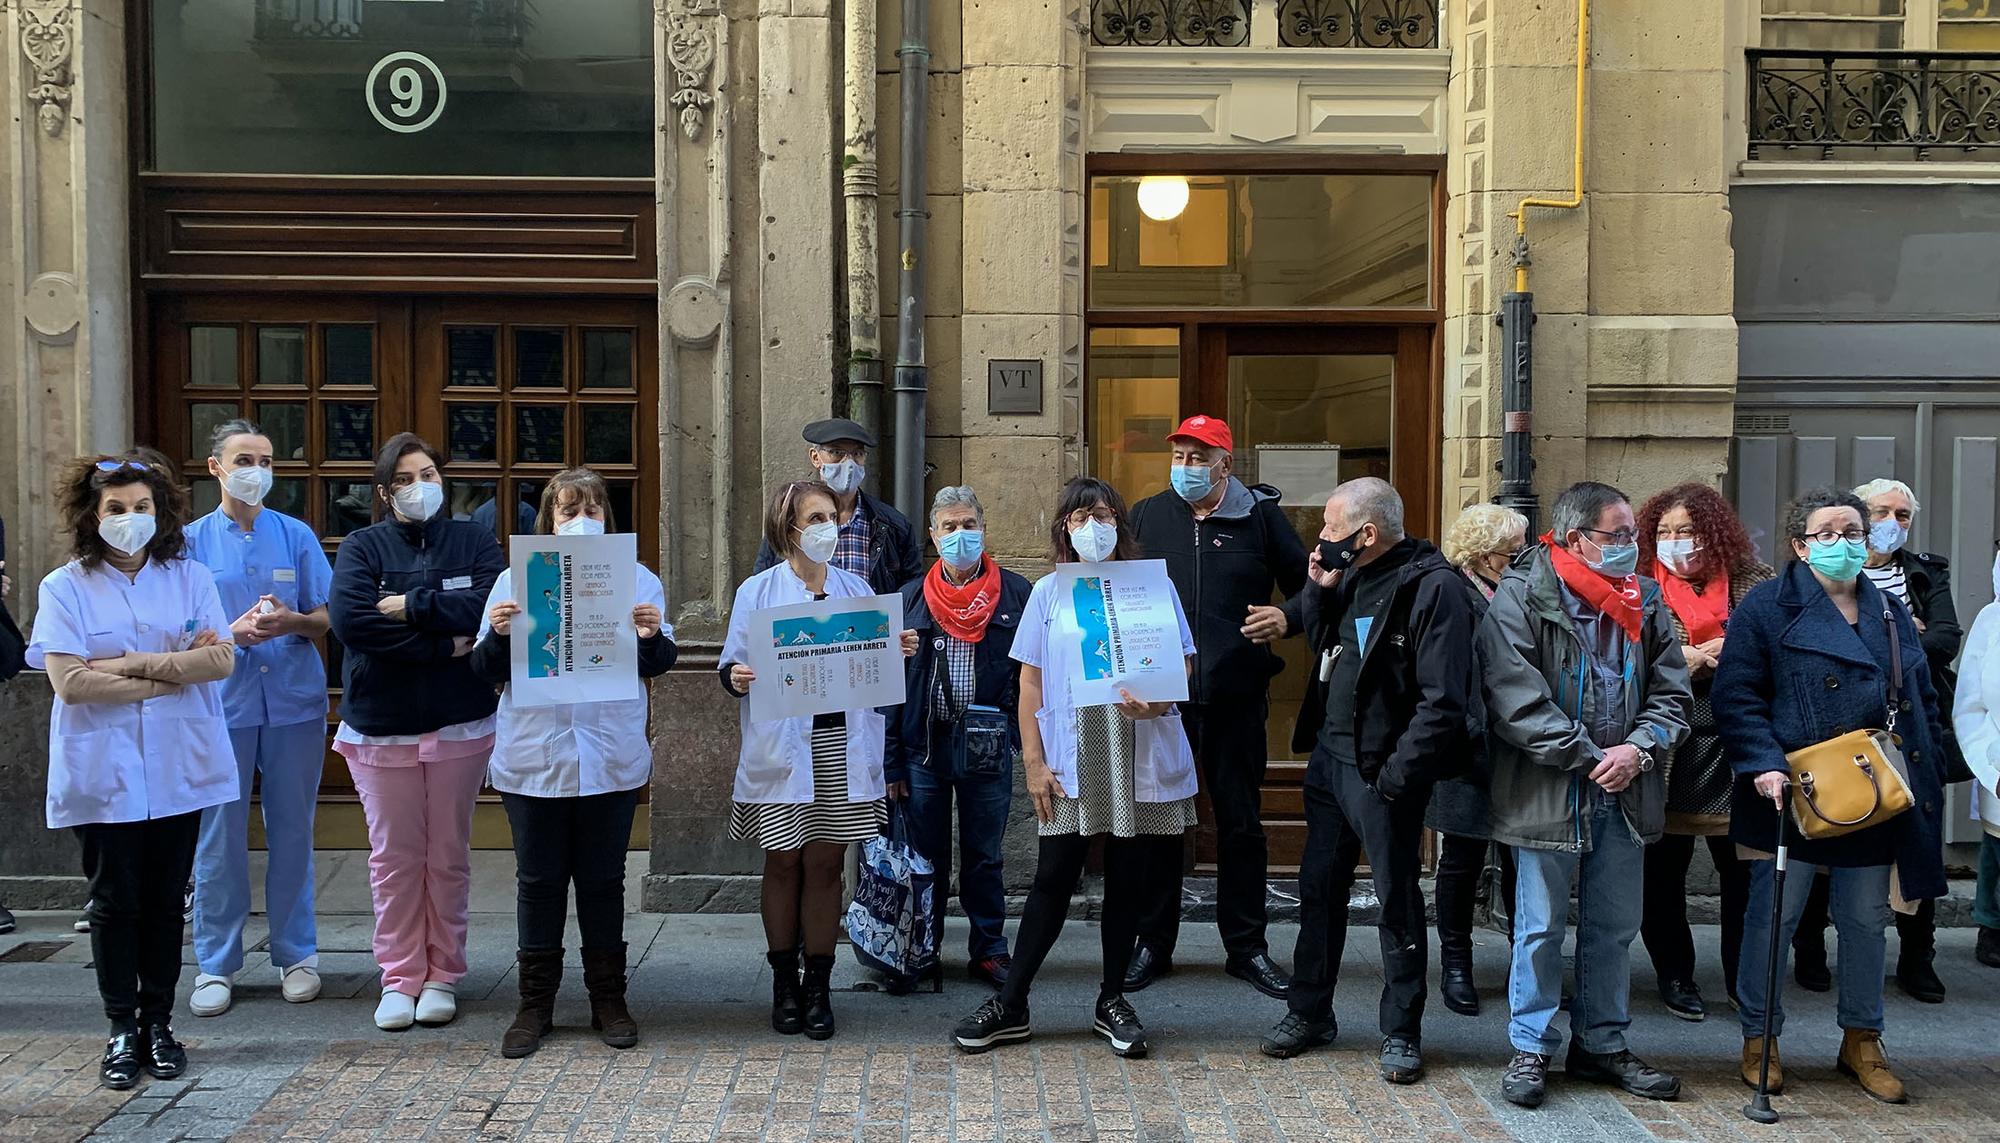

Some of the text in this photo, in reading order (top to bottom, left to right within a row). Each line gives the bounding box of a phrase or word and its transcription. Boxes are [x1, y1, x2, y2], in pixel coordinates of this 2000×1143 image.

[389, 67, 422, 117] 9
[998, 369, 1032, 389] VT
[563, 555, 572, 581] ARRETA
[1104, 579, 1113, 601] ARRETA
[564, 640, 574, 672] ATENCIÓN
[777, 648, 810, 661] ATENCIÓN
[863, 641, 887, 651] ARRETA
[1115, 644, 1126, 673] ATENCIÓN
